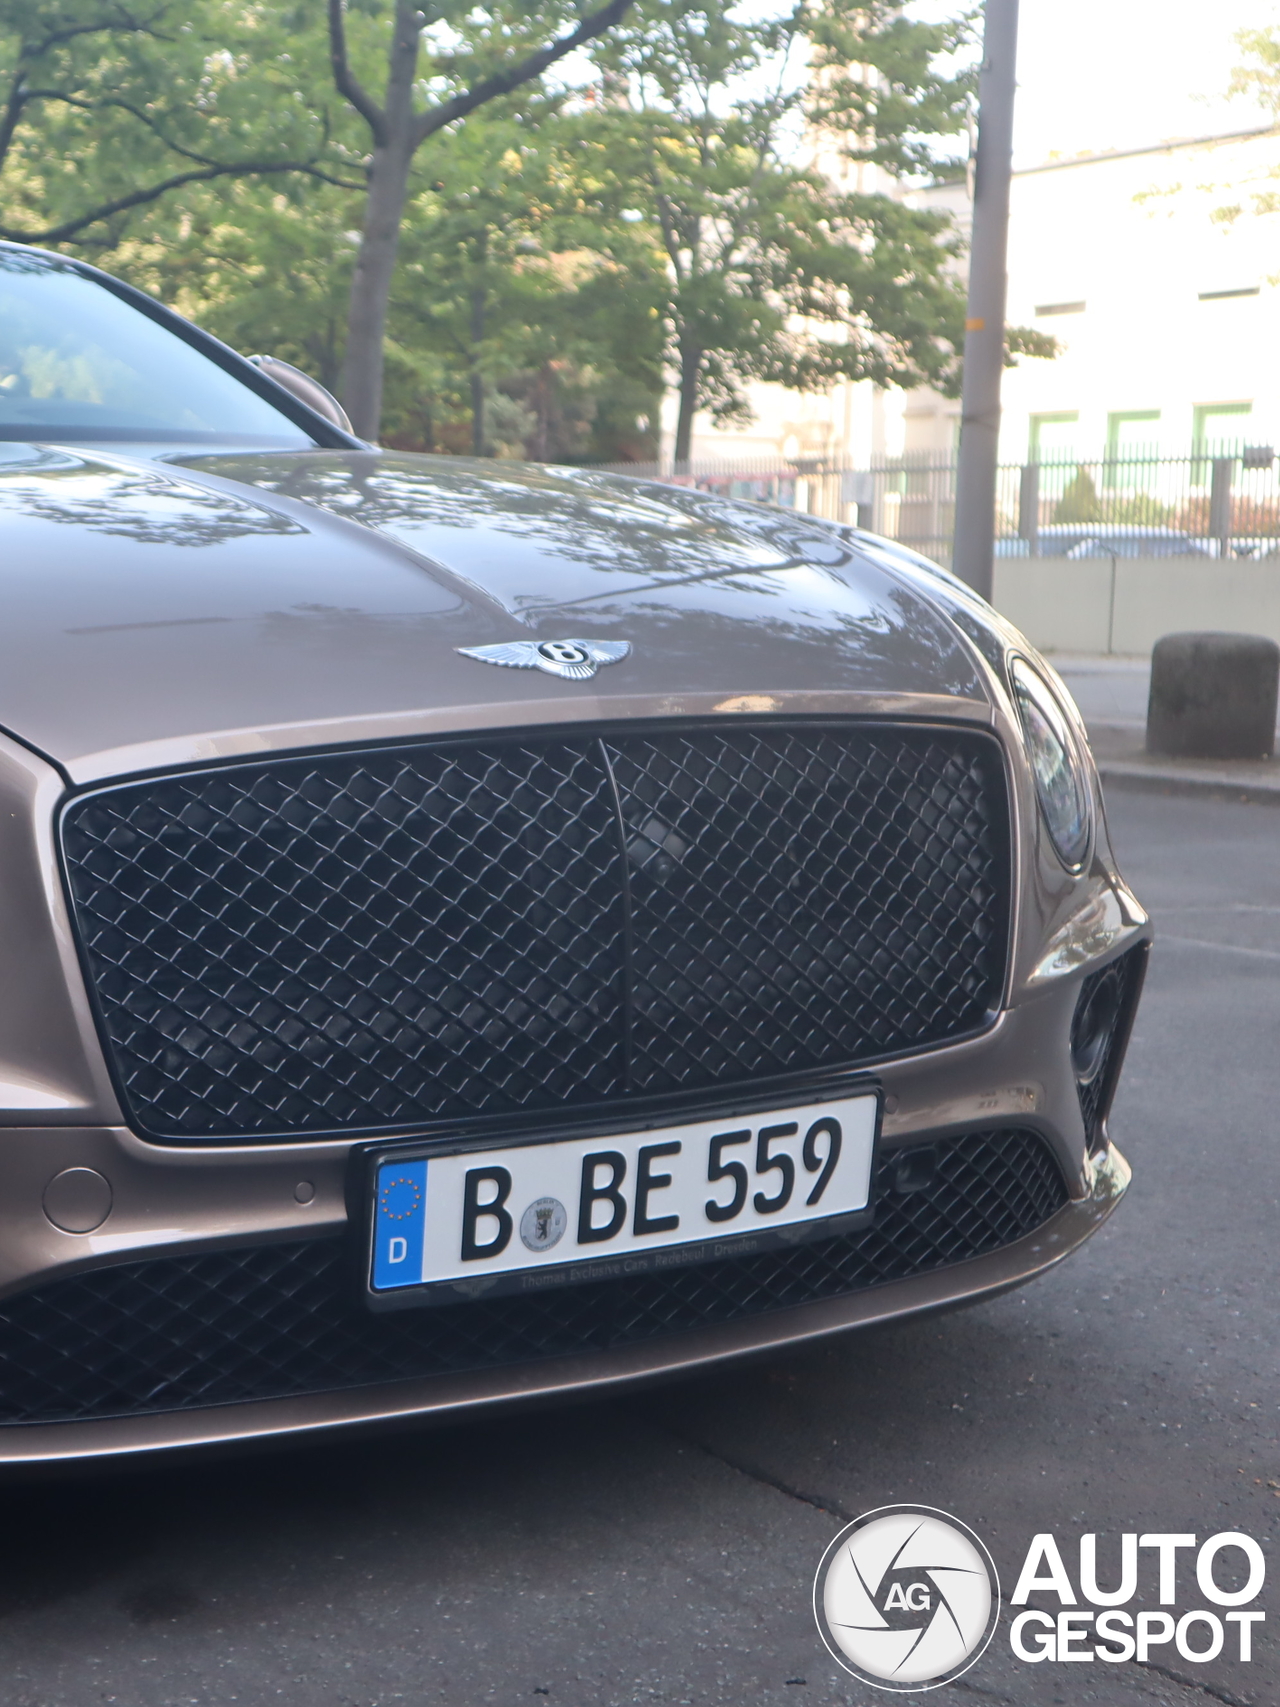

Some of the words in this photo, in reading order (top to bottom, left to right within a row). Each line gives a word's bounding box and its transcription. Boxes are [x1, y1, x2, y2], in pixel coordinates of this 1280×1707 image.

[543, 642, 584, 662] B
[461, 1166, 513, 1262] B
[577, 1140, 682, 1245] BE
[705, 1117, 842, 1223] 559
[388, 1237, 407, 1264] D
[521, 1272, 566, 1288] Thomas
[570, 1264, 620, 1281] Exclusive
[624, 1258, 648, 1272] Cars
[655, 1247, 705, 1266] Radebeul
[714, 1239, 757, 1256] Dresden
